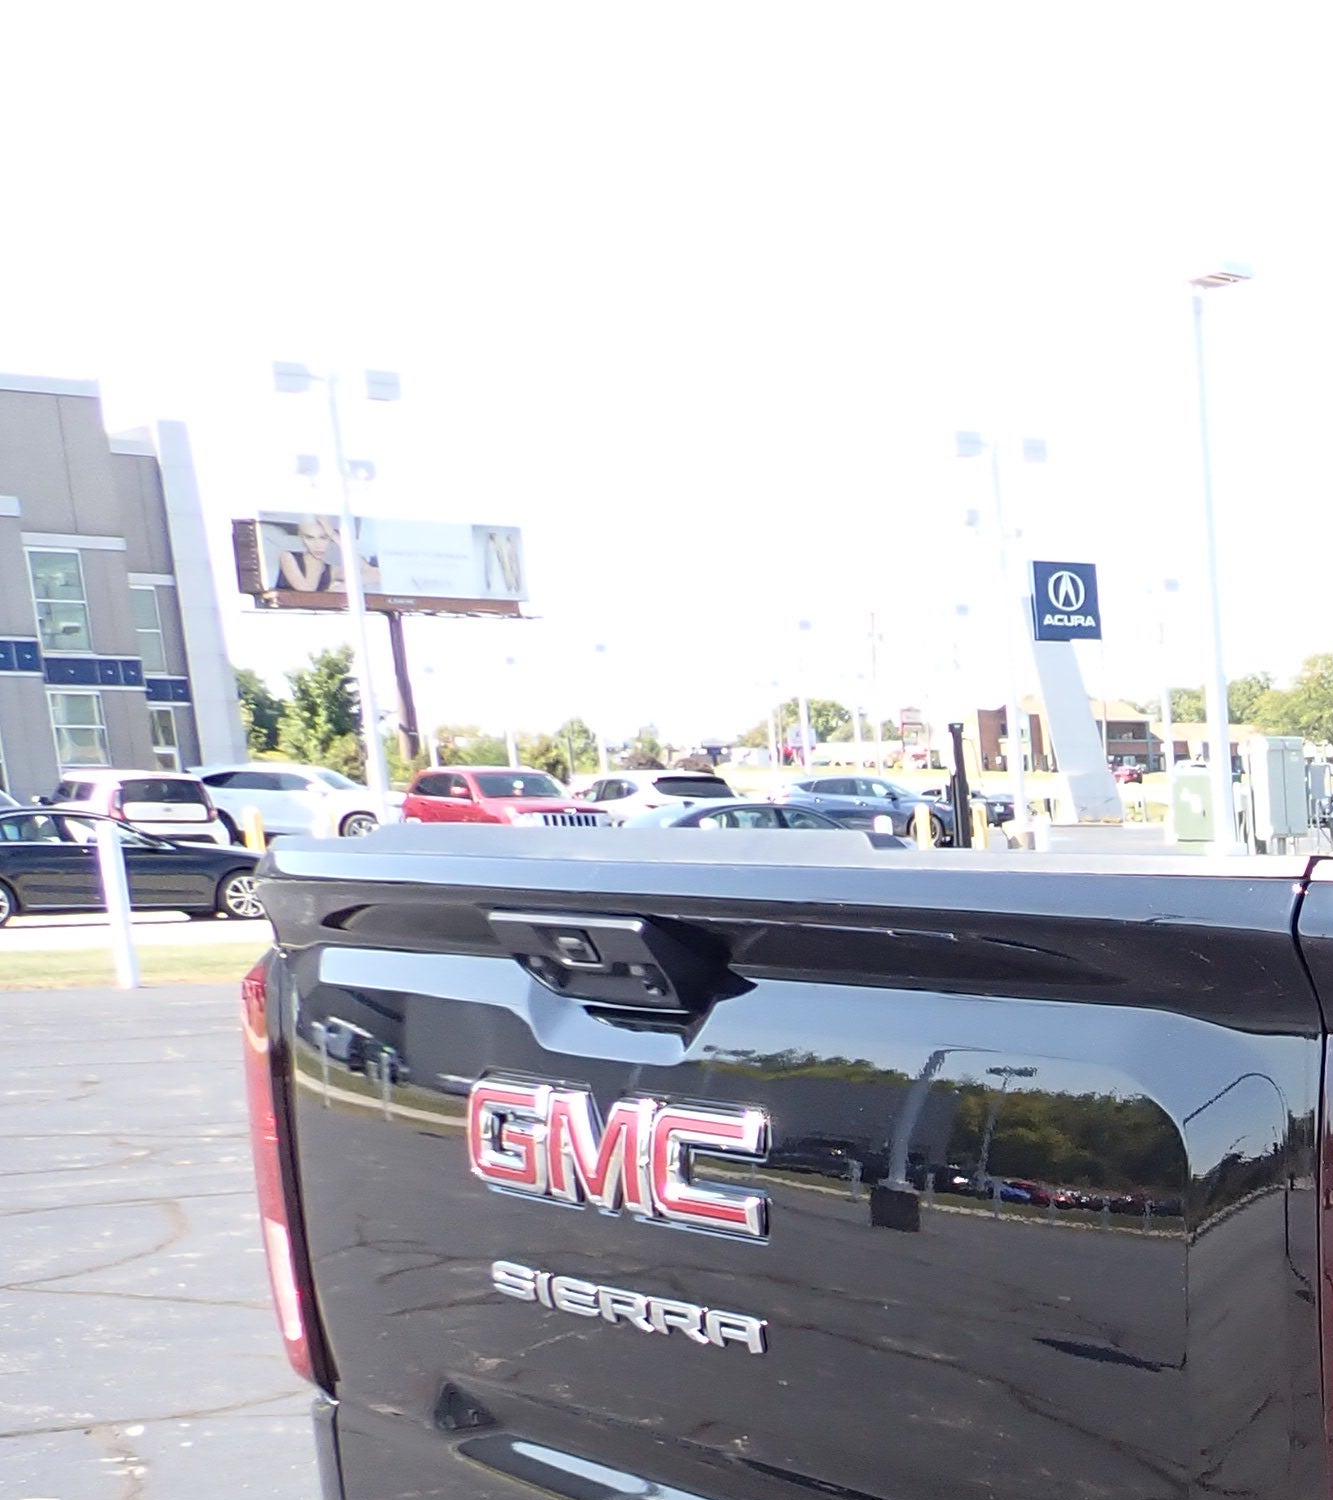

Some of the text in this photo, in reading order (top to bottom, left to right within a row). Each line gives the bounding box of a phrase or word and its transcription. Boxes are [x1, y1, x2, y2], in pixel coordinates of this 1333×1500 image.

[1043, 613, 1096, 627] ACURA
[468, 1073, 772, 1237] GMC
[491, 1260, 768, 1354] SIERRA
